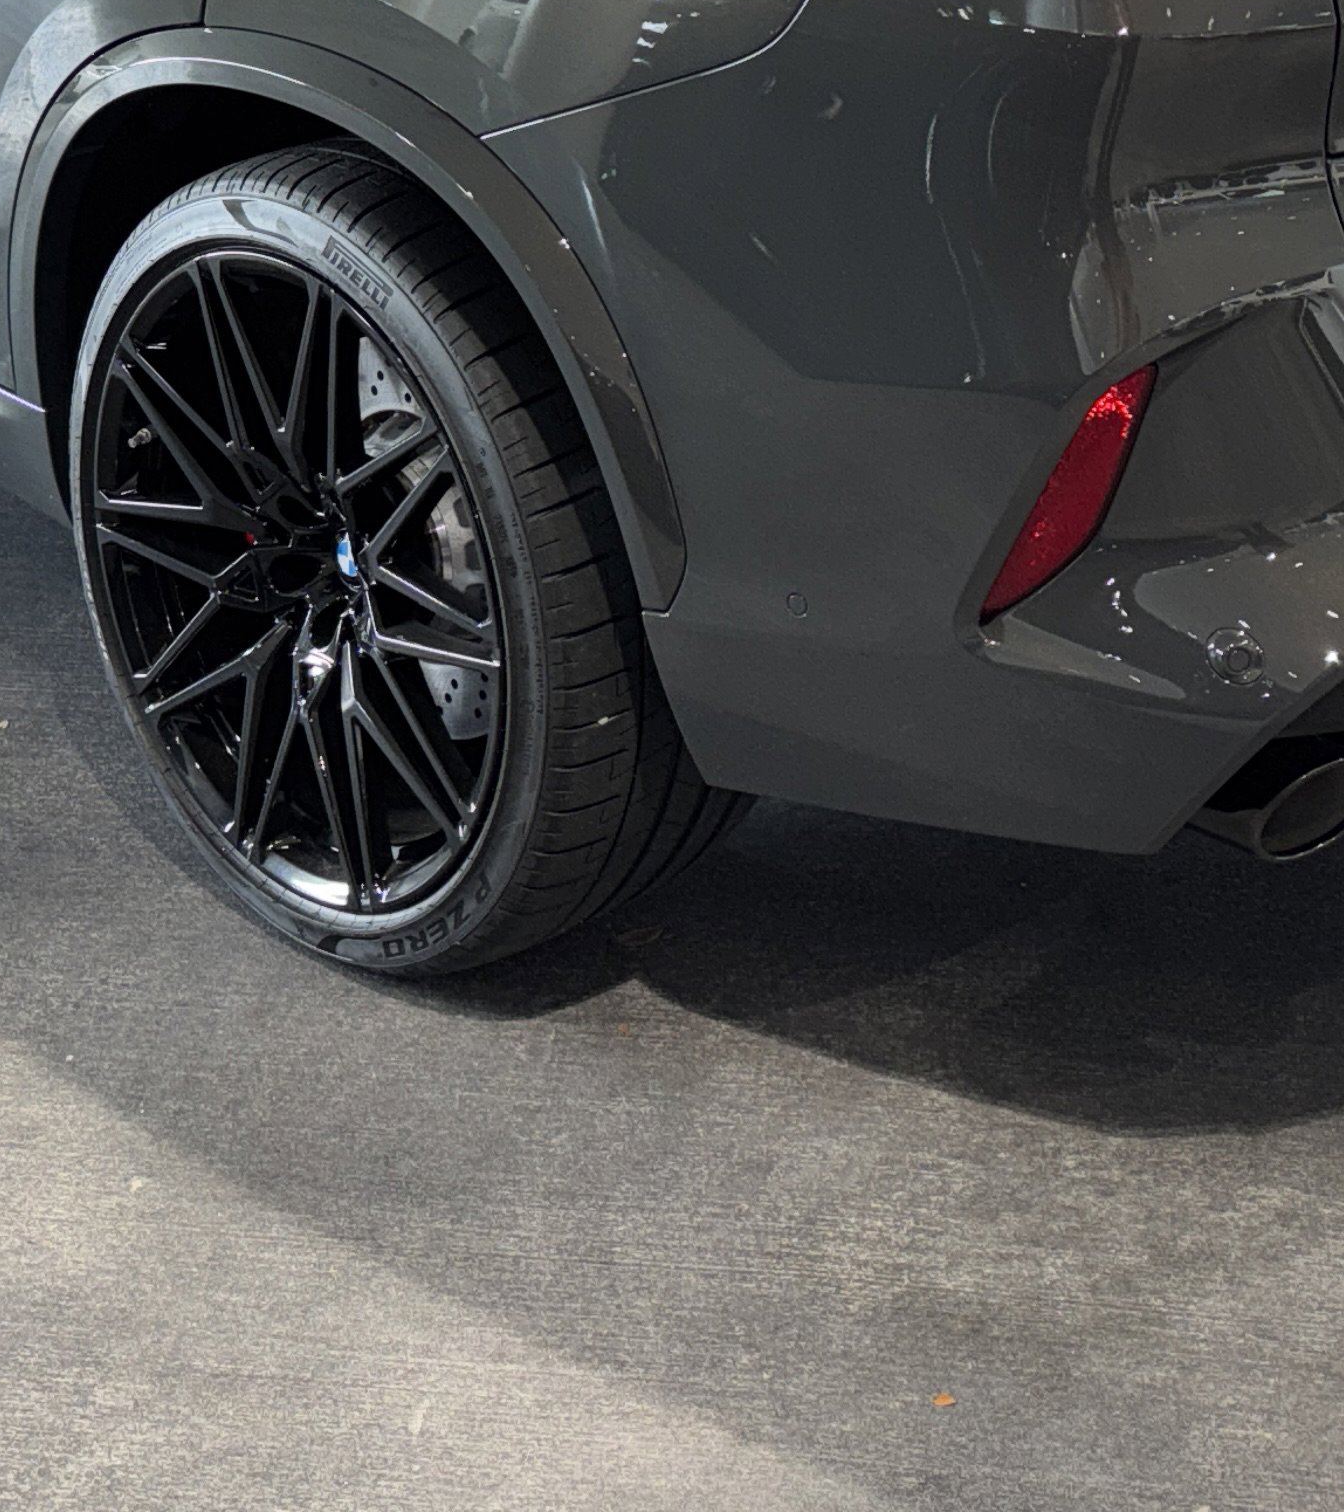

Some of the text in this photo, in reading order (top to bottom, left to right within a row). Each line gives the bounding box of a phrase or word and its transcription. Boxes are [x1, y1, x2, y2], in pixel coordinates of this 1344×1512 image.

[321, 235, 394, 310] PIRELLI
[382, 872, 492, 958] P ZERO
